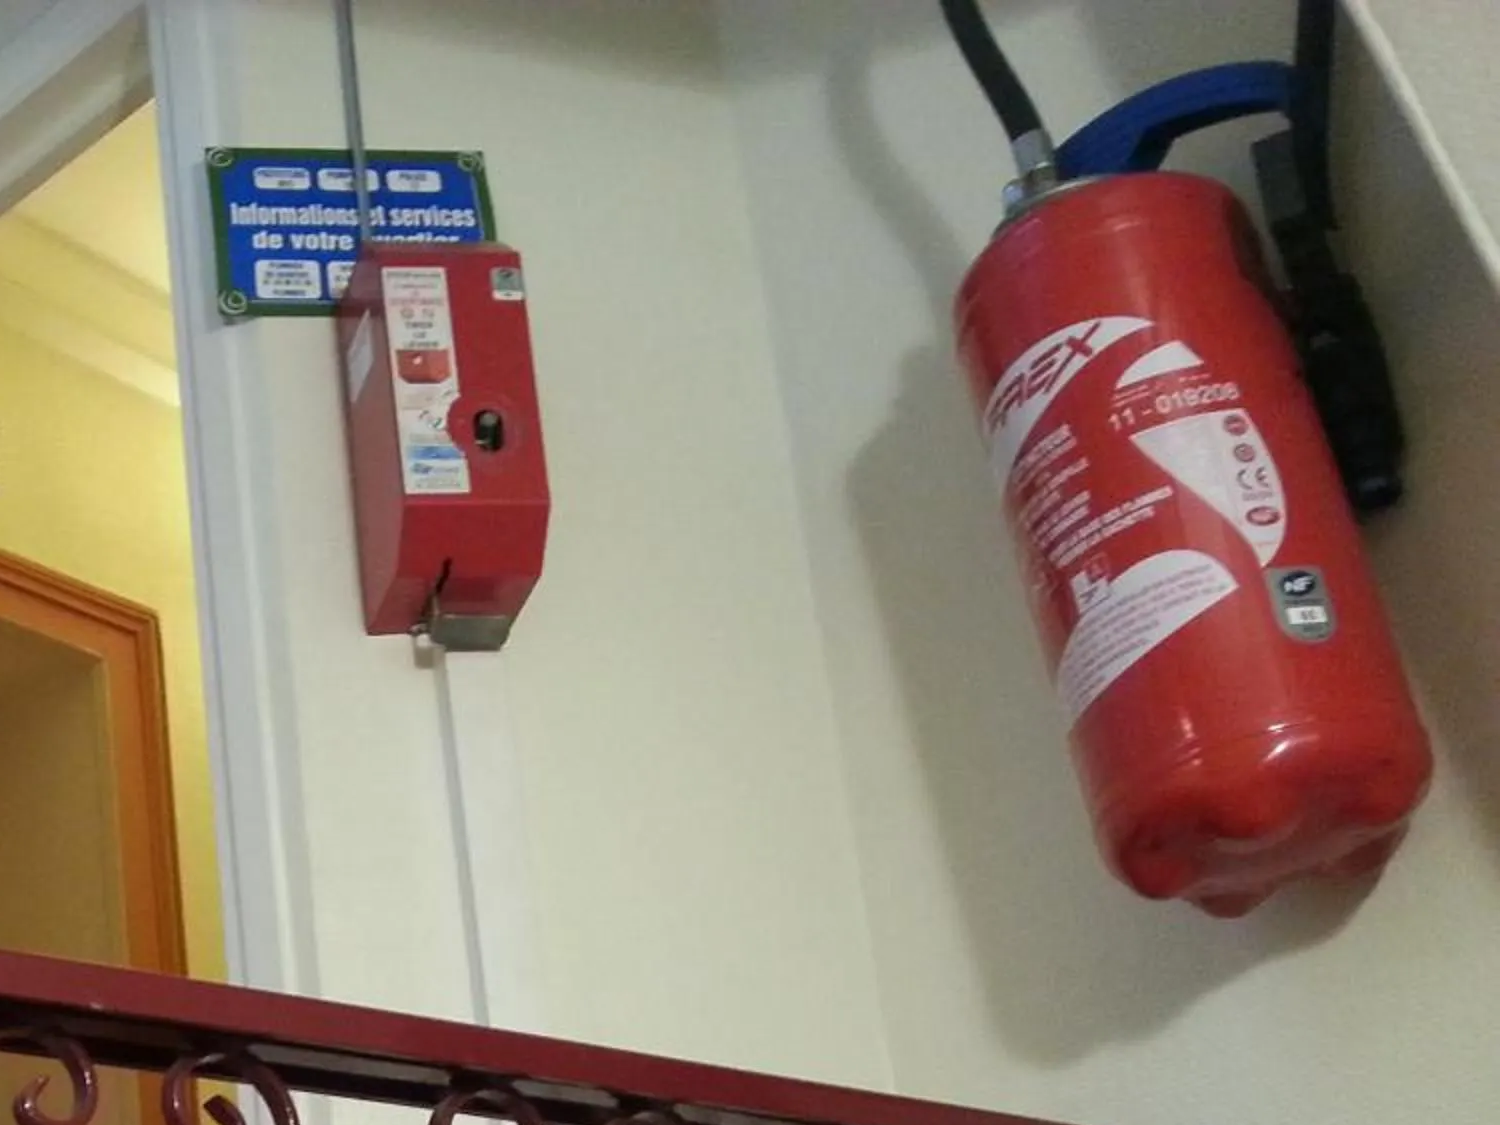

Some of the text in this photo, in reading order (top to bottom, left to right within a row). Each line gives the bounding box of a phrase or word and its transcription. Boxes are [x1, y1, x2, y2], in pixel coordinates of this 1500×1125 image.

[229, 202, 359, 226] Informations
[389, 204, 476, 227] services
[252, 229, 283, 249] de
[290, 231, 355, 250] votre
